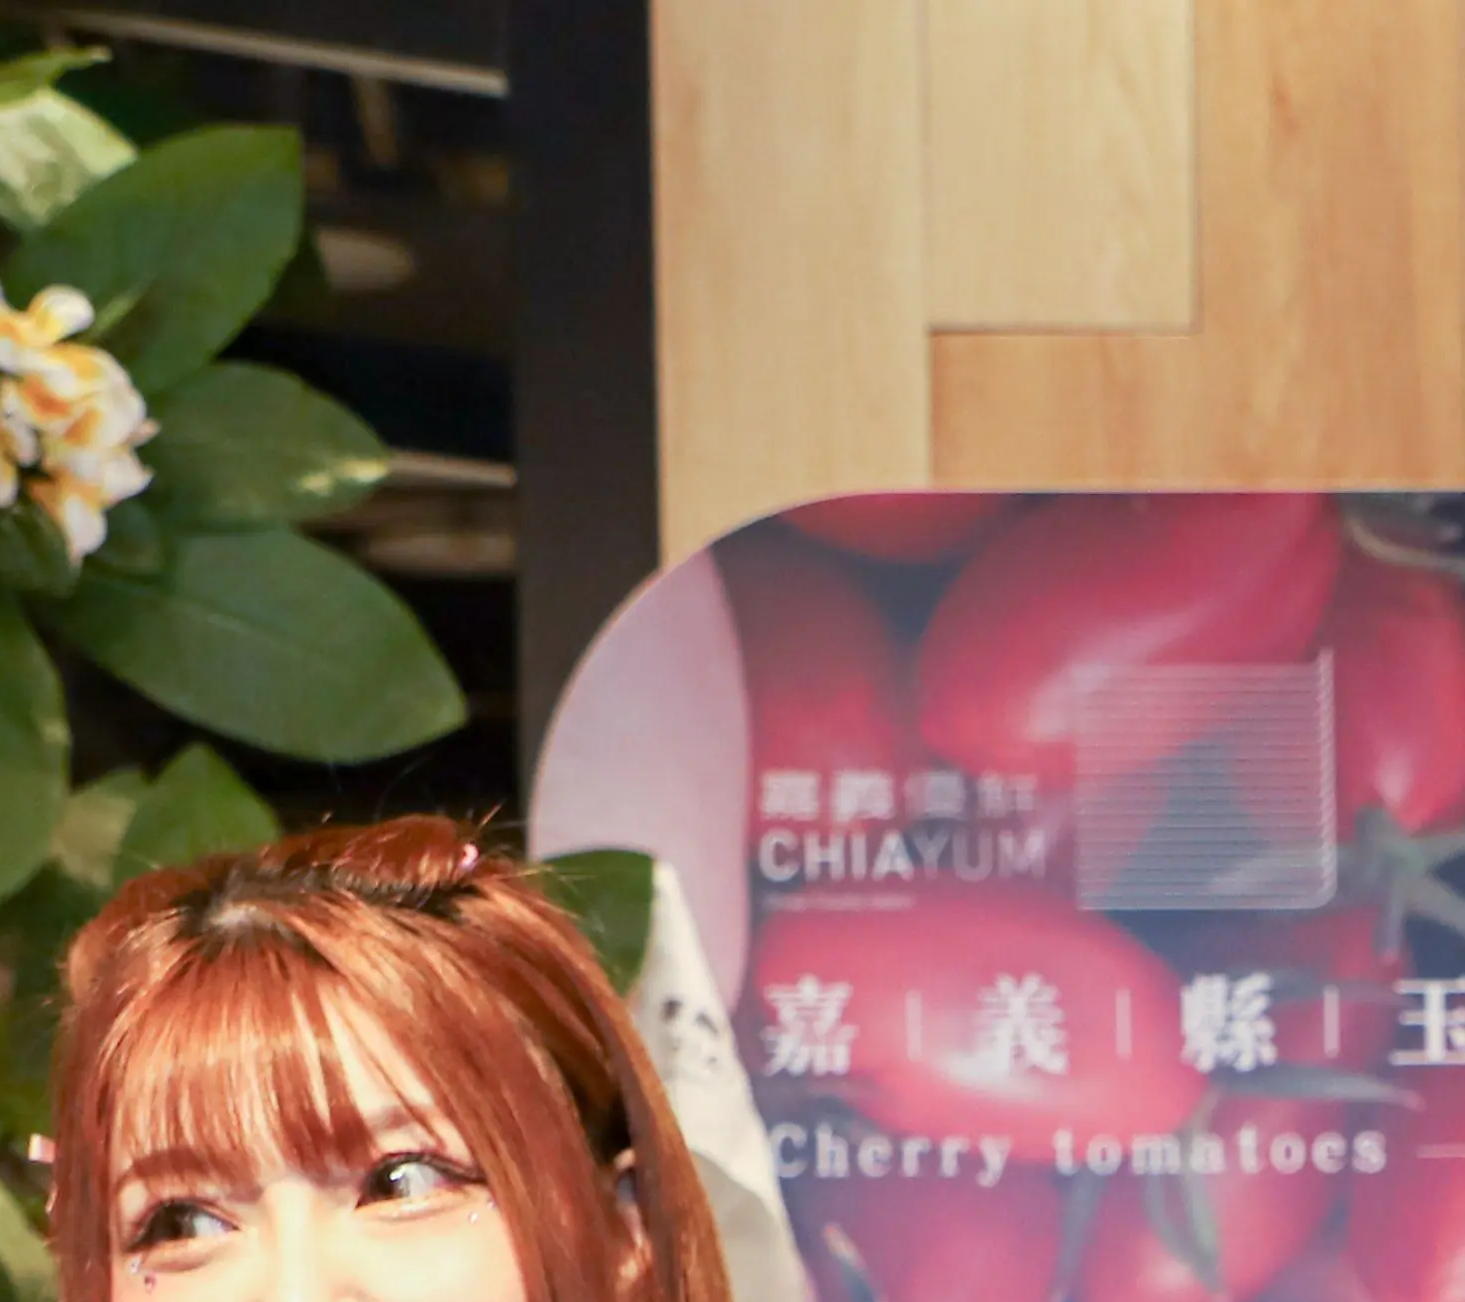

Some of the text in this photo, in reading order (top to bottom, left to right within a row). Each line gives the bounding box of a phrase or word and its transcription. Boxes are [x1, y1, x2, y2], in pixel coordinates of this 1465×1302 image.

[758, 829, 1046, 882] CHIAYUM
[768, 1122, 1388, 1188] Cherry tomatoes
